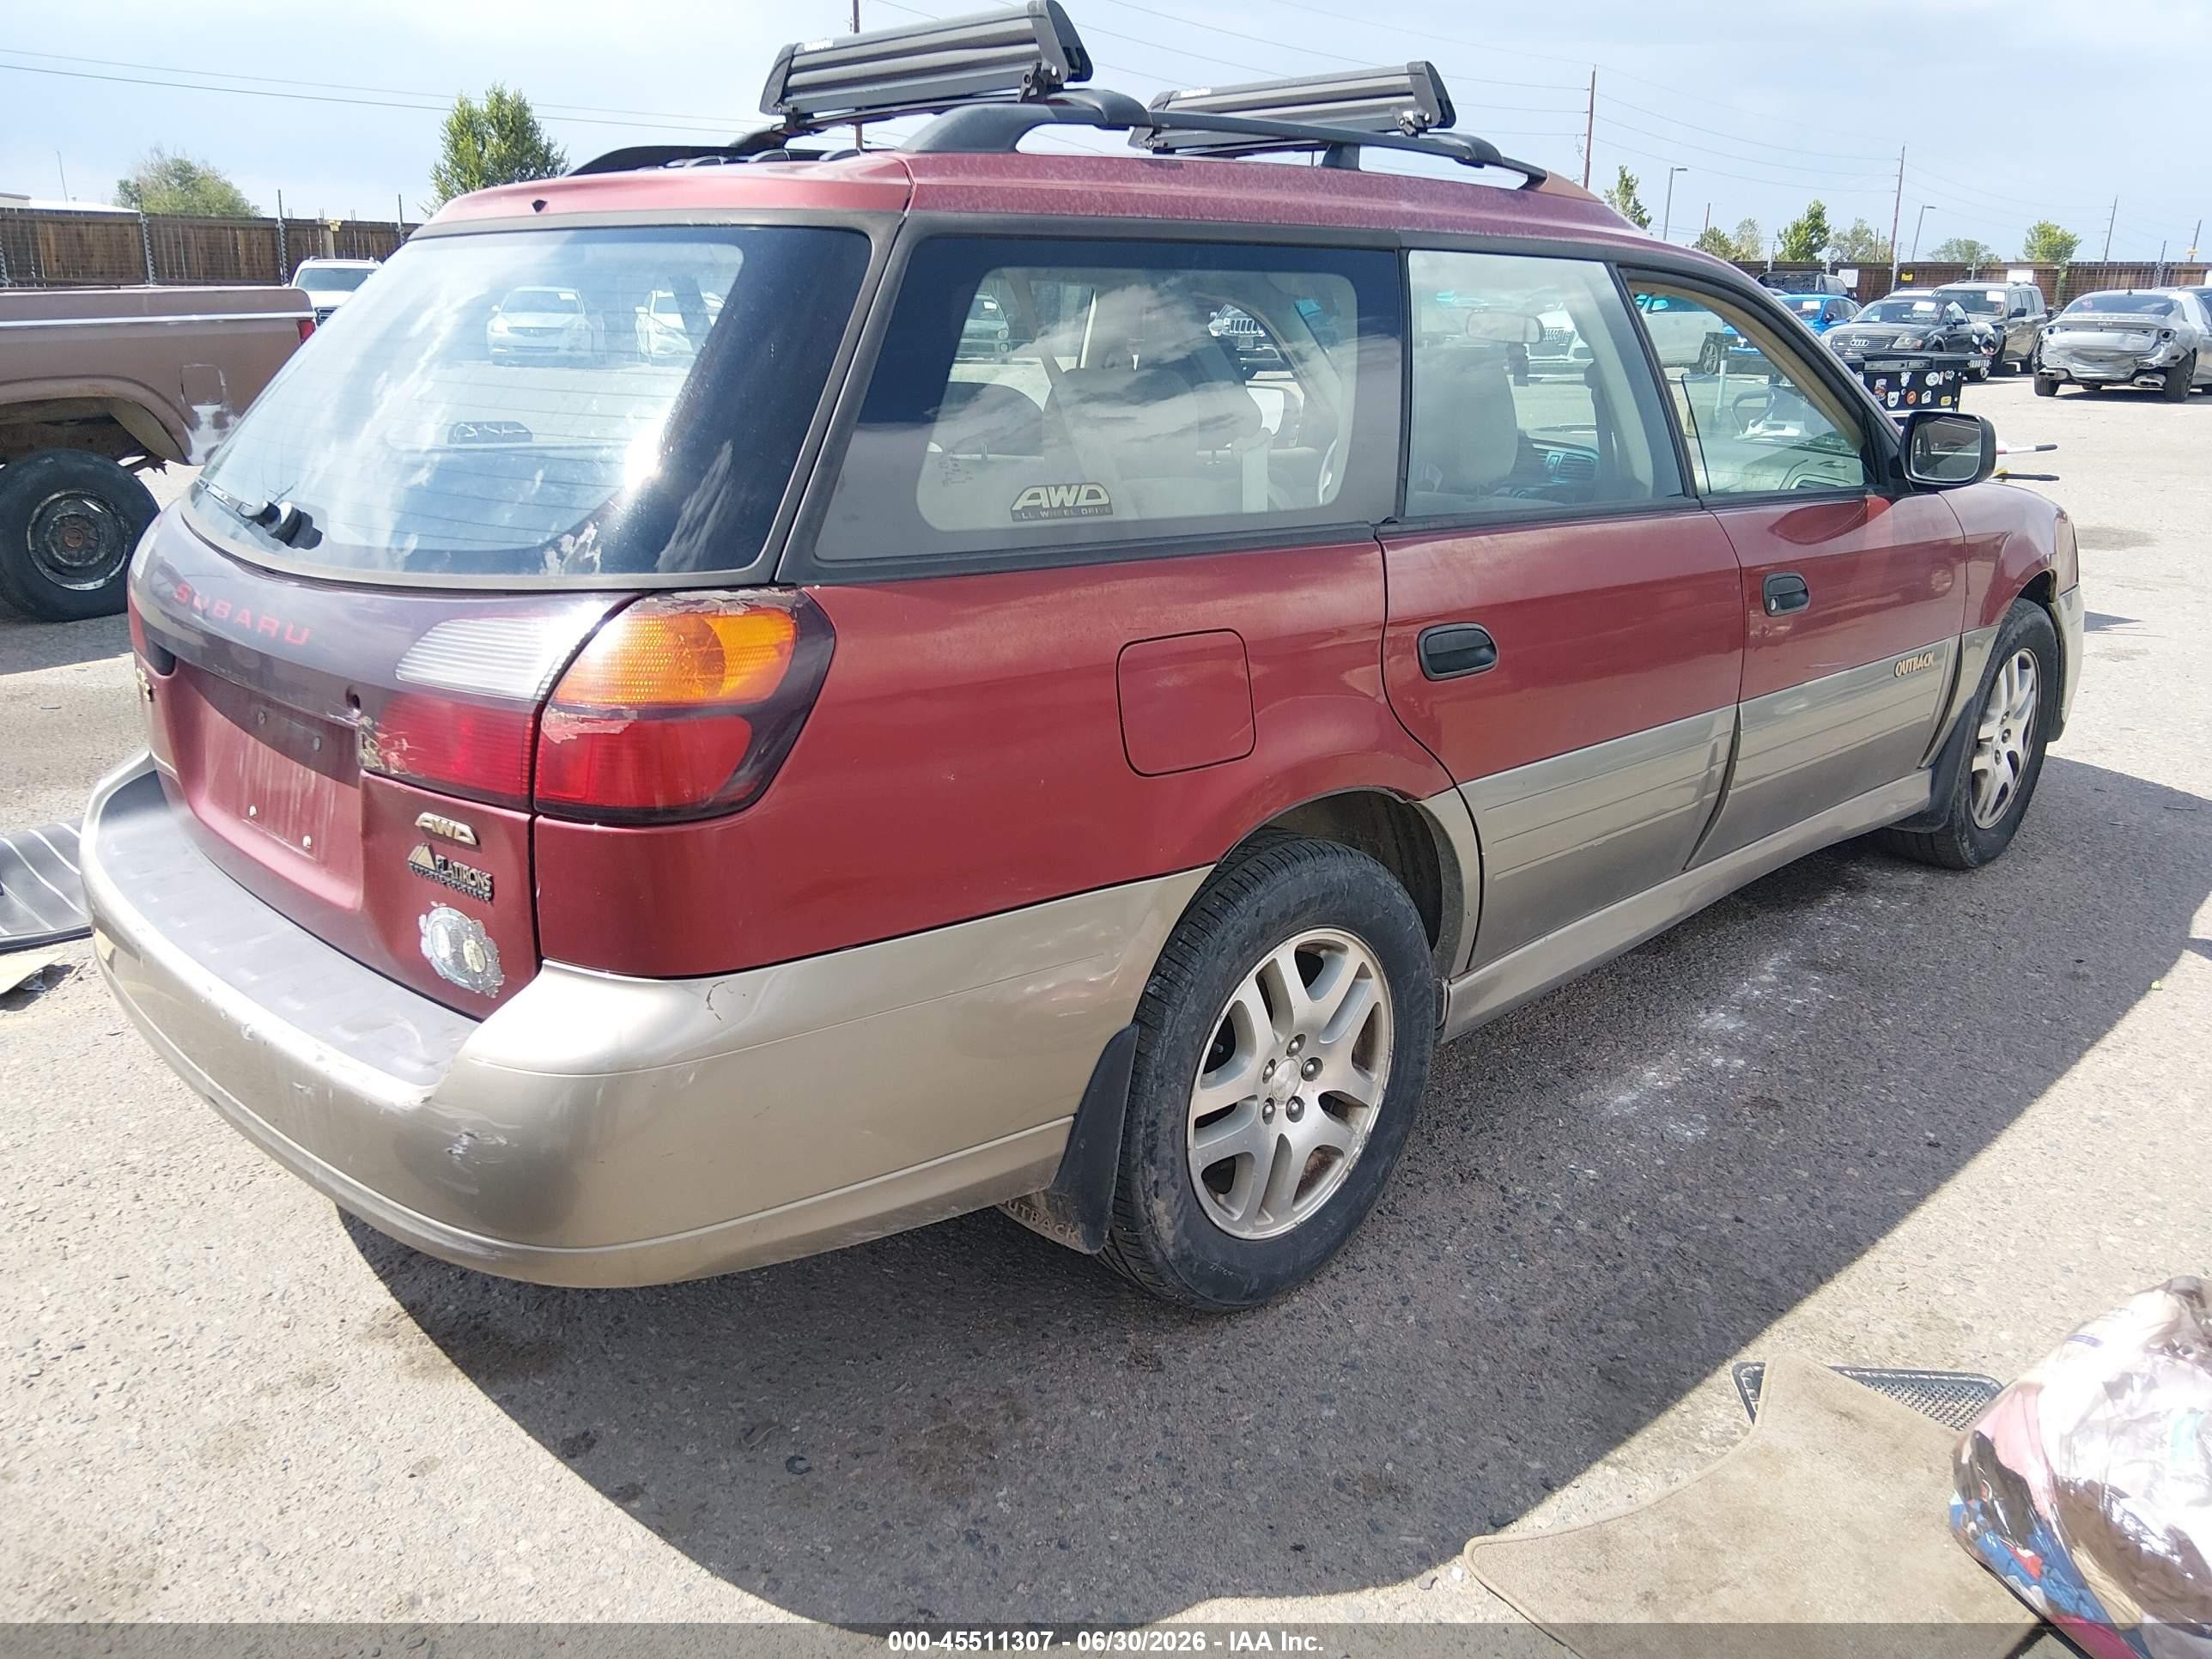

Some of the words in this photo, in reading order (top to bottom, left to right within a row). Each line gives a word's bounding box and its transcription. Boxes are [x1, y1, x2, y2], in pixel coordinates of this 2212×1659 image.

[1012, 483, 1110, 510] AWD
[173, 581, 311, 646] SUBARU
[1895, 651, 1935, 678] OUTBACK
[415, 811, 479, 846] AWD
